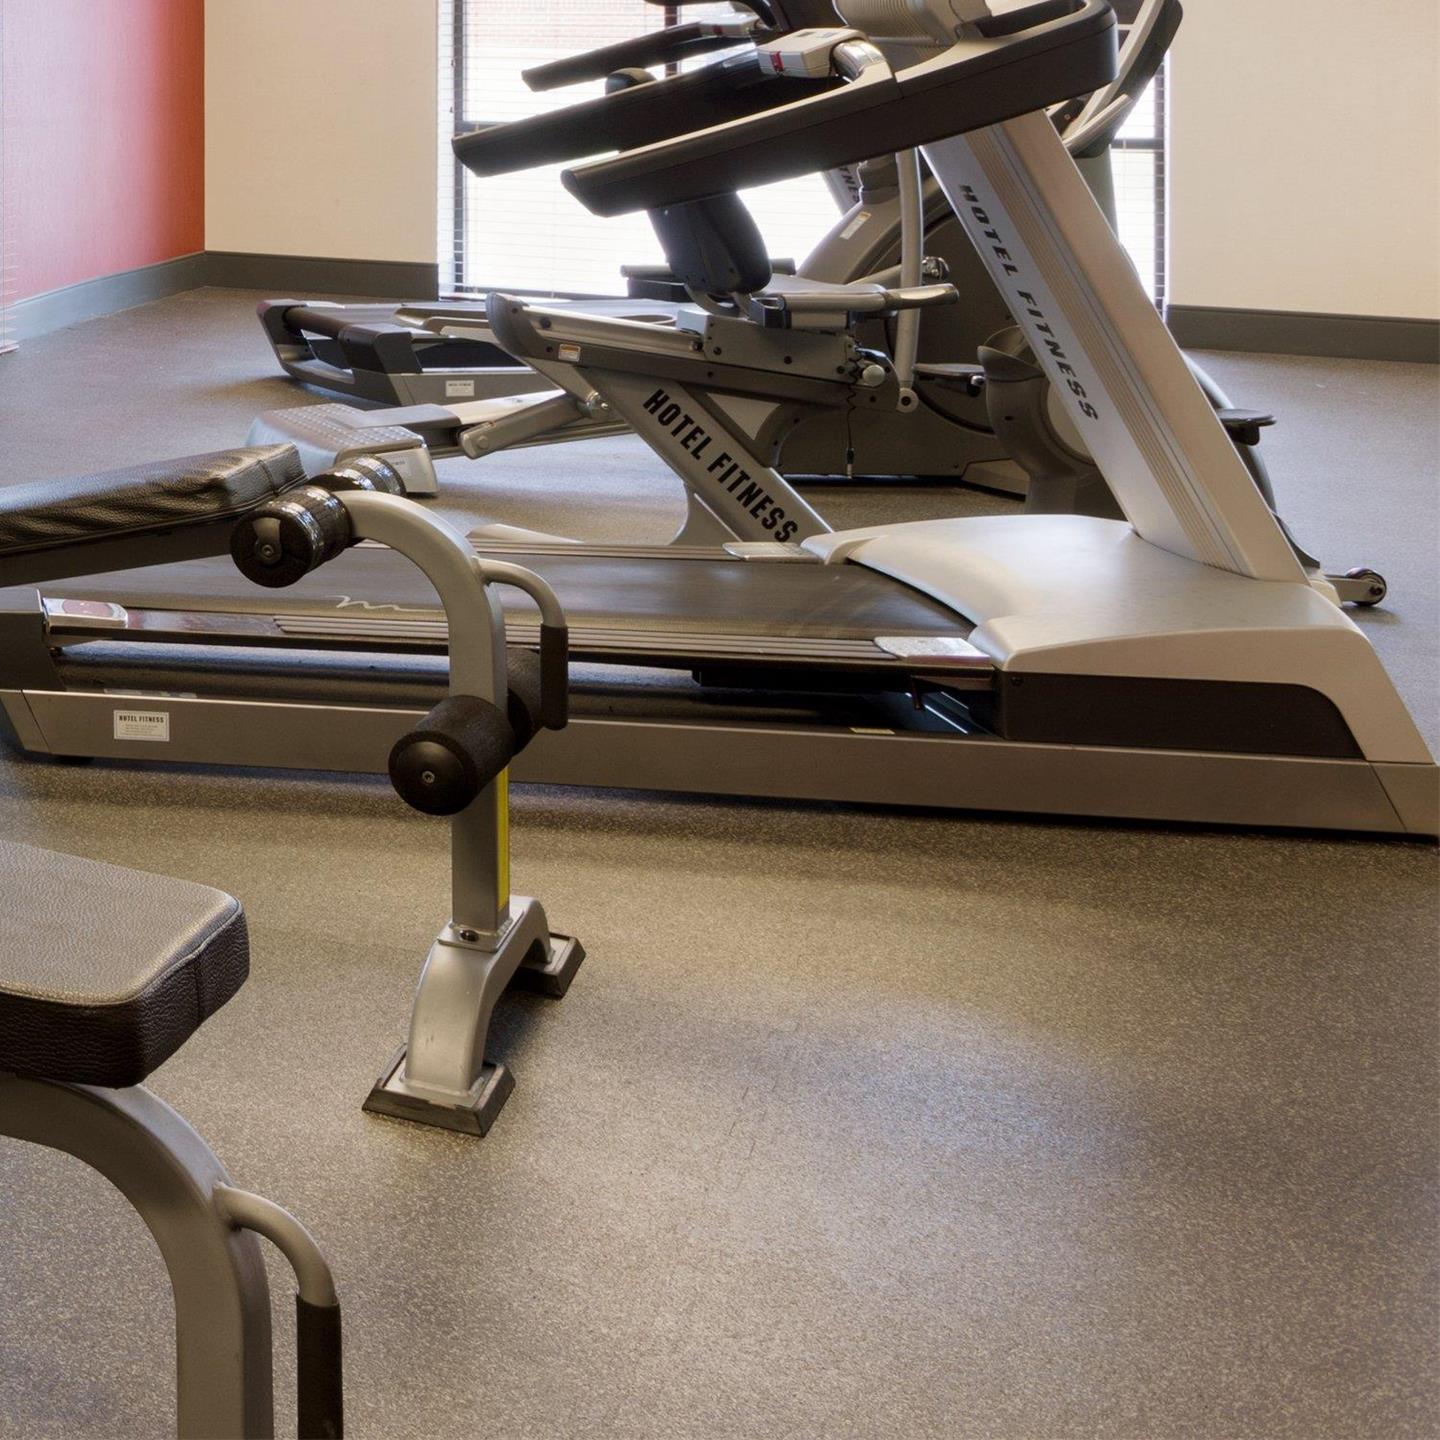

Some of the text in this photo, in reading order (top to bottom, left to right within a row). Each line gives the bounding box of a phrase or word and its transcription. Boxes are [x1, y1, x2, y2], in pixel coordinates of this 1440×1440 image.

[958, 183, 1098, 421] HOTEL FITNESS
[643, 388, 799, 543] HOTEL FITNESS
